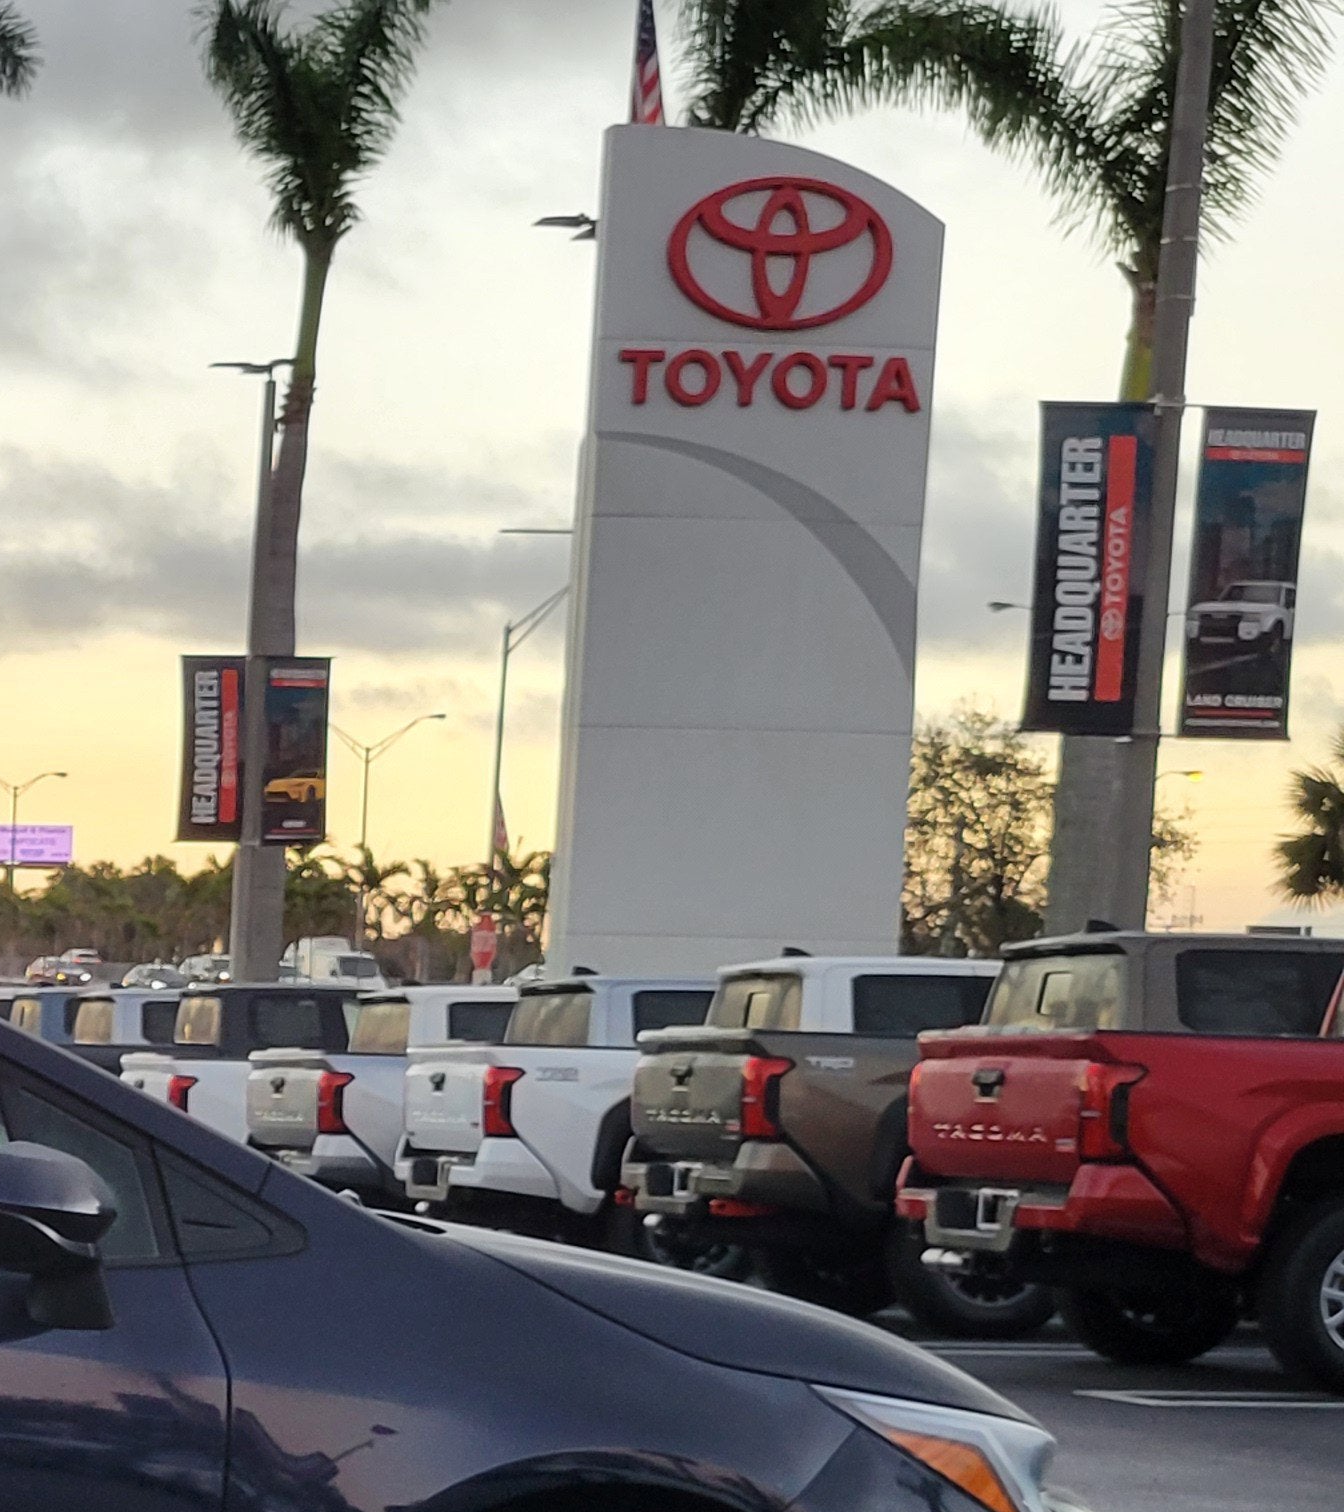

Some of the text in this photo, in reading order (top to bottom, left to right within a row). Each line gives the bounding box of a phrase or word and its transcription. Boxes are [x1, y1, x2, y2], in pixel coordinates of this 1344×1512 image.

[619, 348, 922, 413] TOYOTA
[1047, 436, 1104, 702] HEADQUARTER
[1105, 506, 1129, 603] TOYOTA
[190, 671, 221, 824] HEADQUARTER
[932, 1122, 1048, 1143] TACOMA
